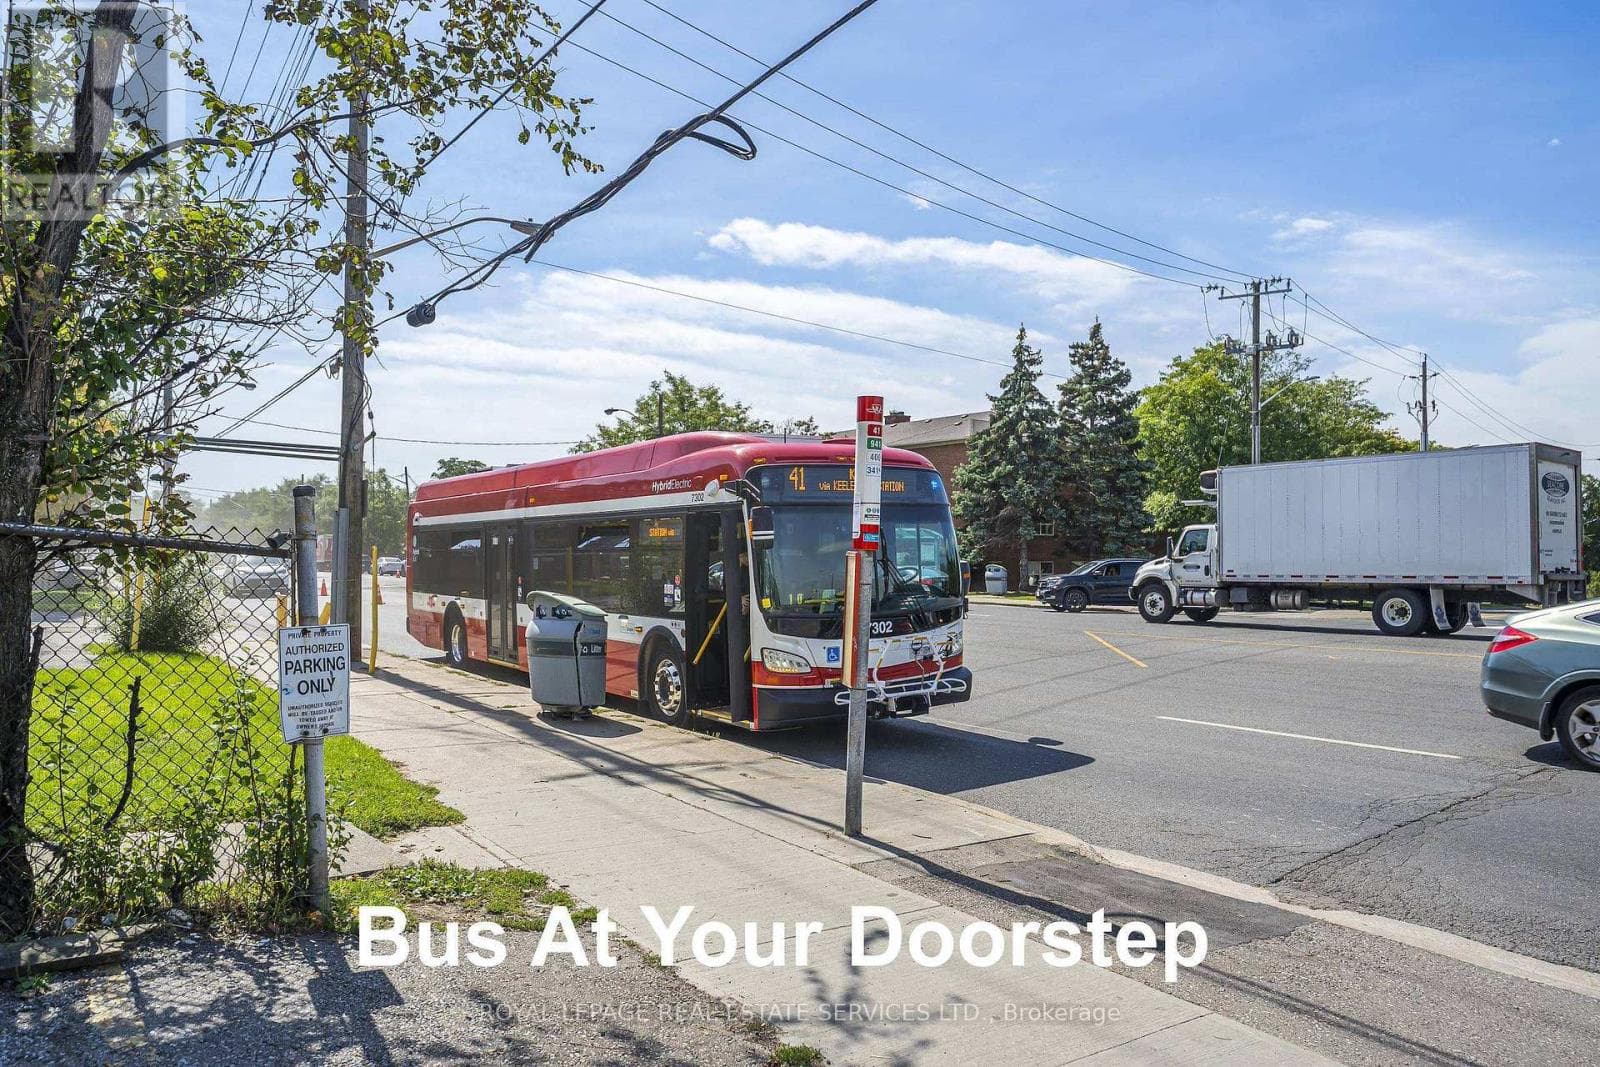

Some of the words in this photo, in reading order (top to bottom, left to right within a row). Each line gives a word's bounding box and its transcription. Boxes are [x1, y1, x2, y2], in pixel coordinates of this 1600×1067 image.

[789, 466, 806, 490] 41
[652, 479, 692, 493] HybridElectric
[880, 482, 904, 491] TATION
[691, 493, 704, 502] 7302
[314, 630, 342, 638] PROPERTY
[869, 621, 893, 634] 302
[285, 643, 344, 656] AUTHORIZED
[285, 656, 346, 676] PARKING
[297, 678, 336, 695] ONLY
